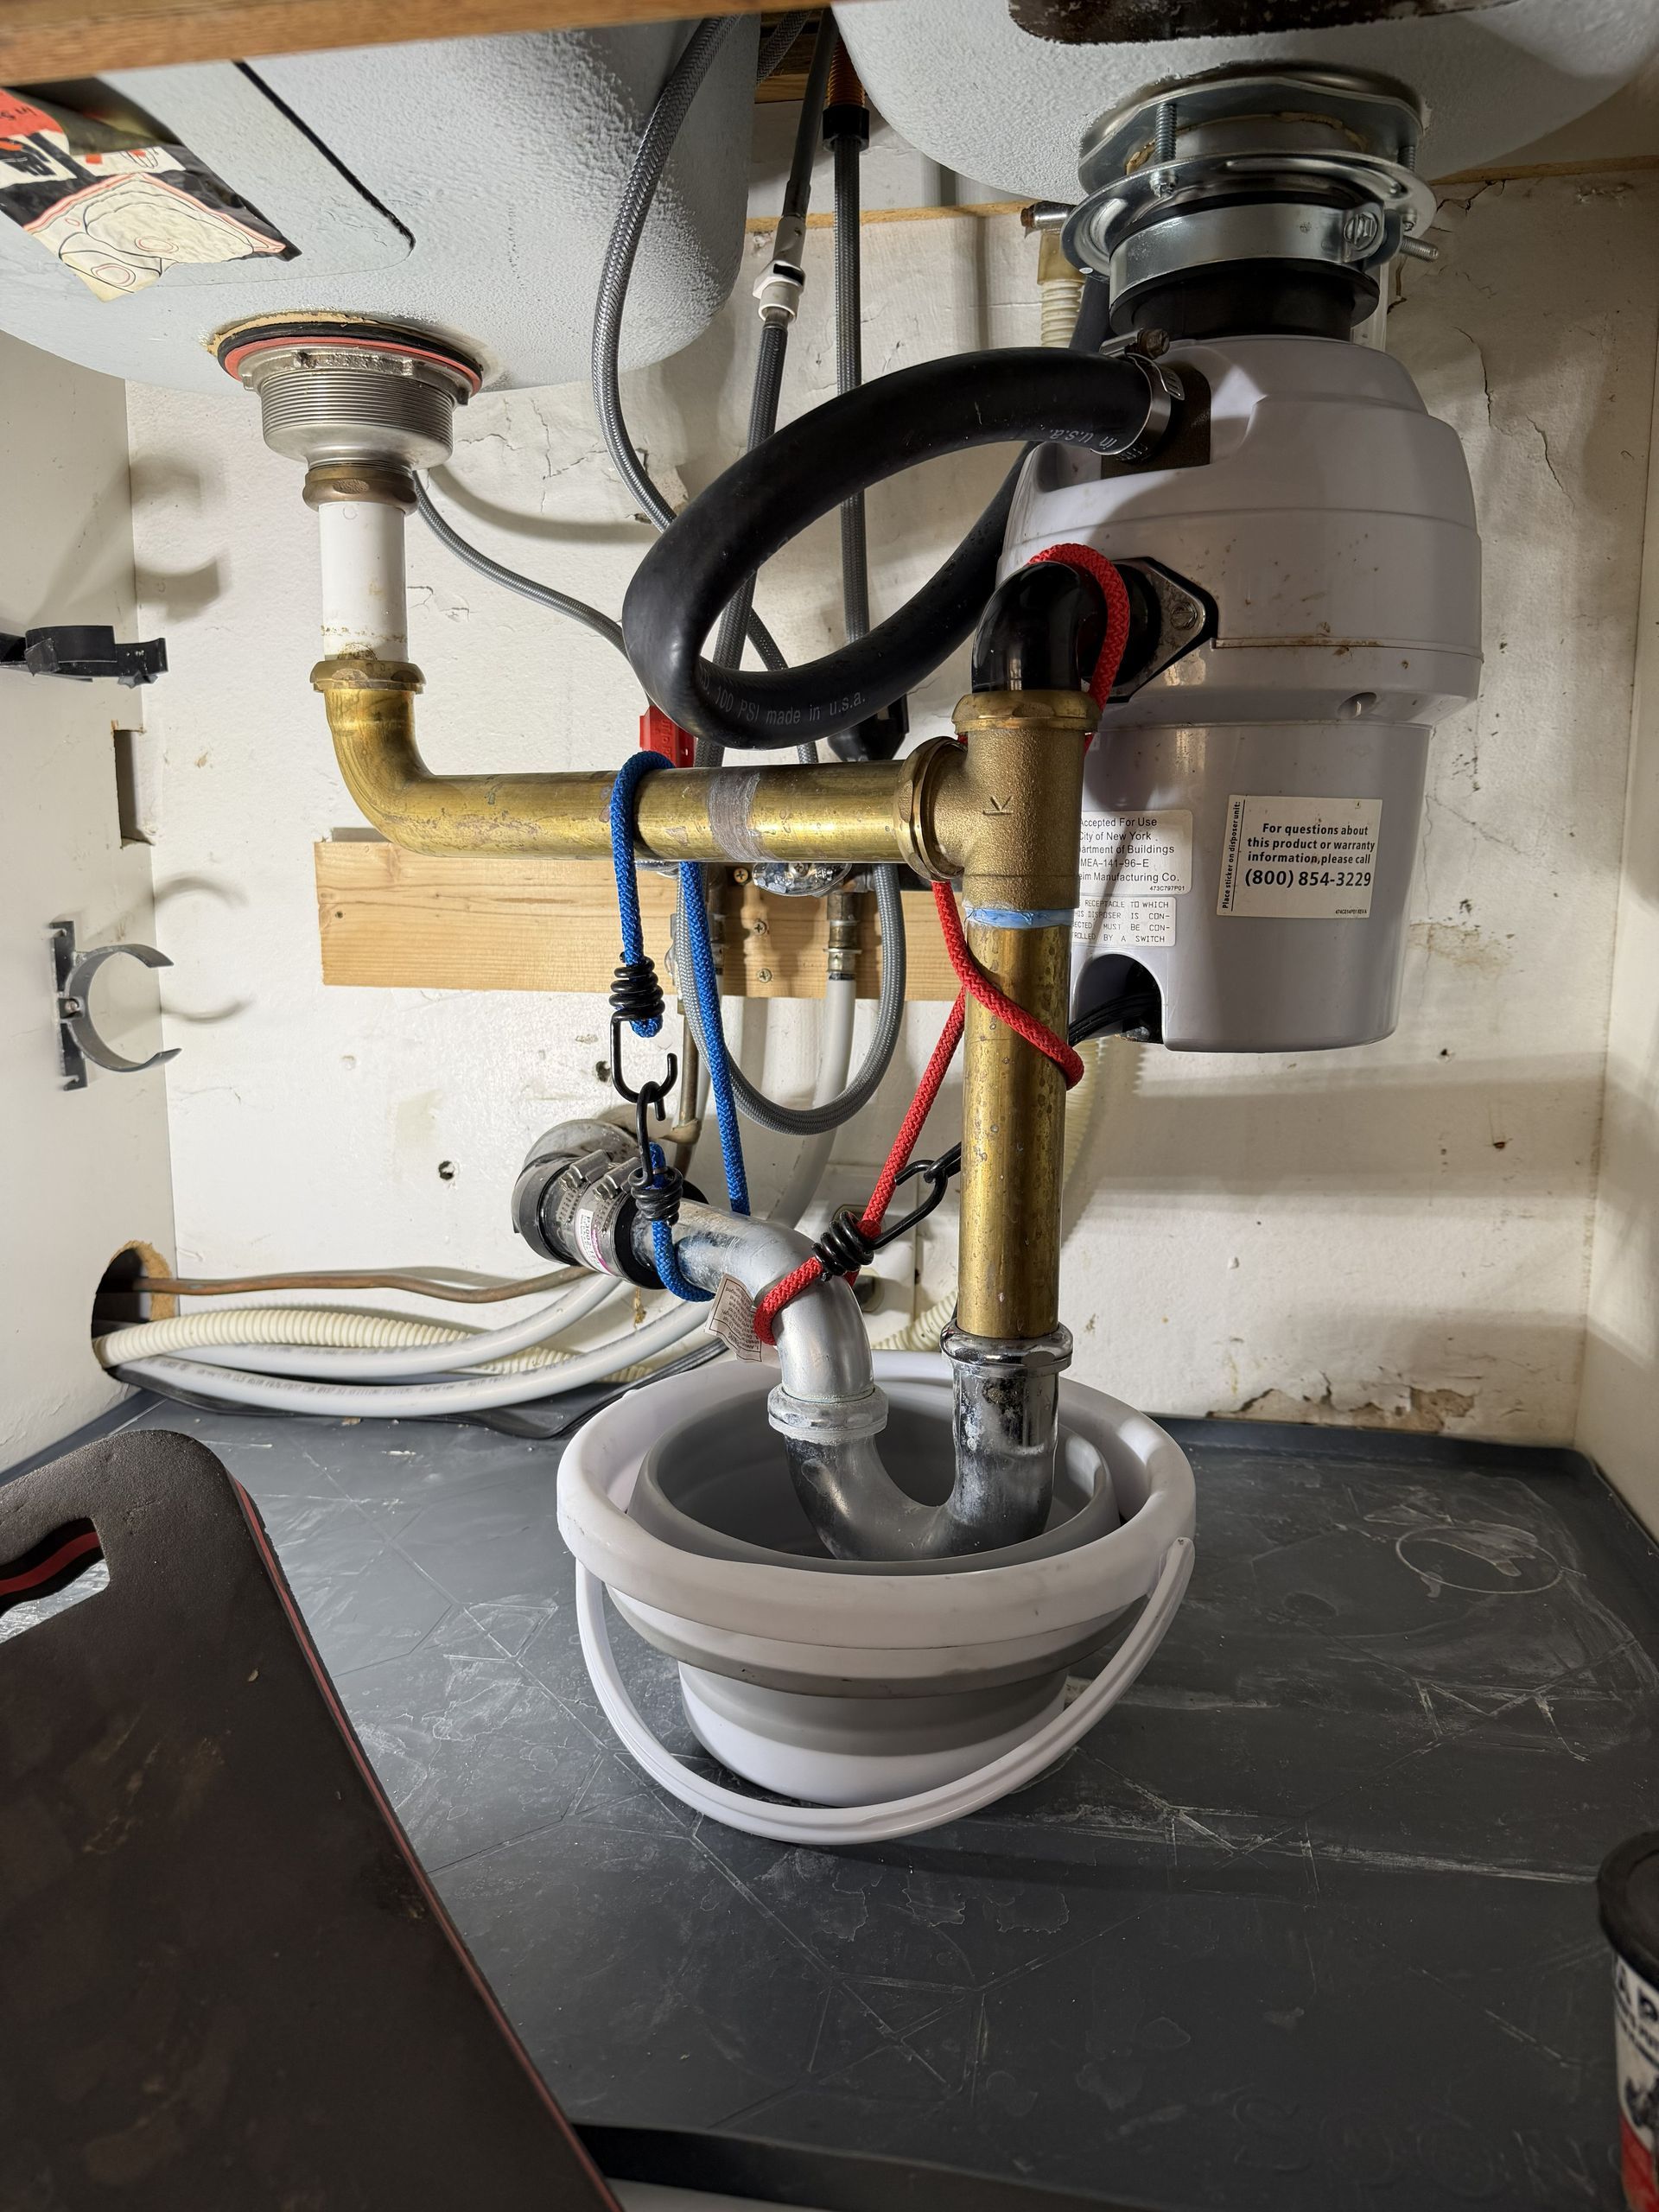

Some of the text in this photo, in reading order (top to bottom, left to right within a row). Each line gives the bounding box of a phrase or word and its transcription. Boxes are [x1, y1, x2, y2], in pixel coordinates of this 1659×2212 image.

[1050, 429, 1118, 450] in u.s.a.
[715, 686, 734, 713] 100
[737, 698, 760, 722] PSI
[766, 708, 802, 725] made
[809, 703, 821, 722] in
[829, 691, 866, 716] u.s.a.
[1119, 817, 1135, 827] For
[1137, 817, 1158, 827] Use
[1262, 823, 1369, 836] For questions about
[1095, 831, 1104, 841] of
[1106, 831, 1127, 841] New
[1129, 831, 1152, 841] York
[1229, 821, 1238, 852] disposer
[1080, 845, 1175, 855] artment of Buildings
[1247, 837, 1270, 848] this
[1272, 838, 1319, 850] product
[1333, 841, 1376, 853] warranty
[1228, 853, 1235, 863] on
[1355, 854, 1371, 864] call
[1093, 872, 1160, 883] Manufacturing
[1161, 872, 1180, 882] Co.
[1224, 864, 1234, 888] sticker
[1245, 868, 1372, 888] (800) 854-3229
[1084, 899, 1126, 908] RECEPTACLE
[1222, 890, 1230, 909] Place
[1088, 911, 1122, 919] DISPOSER
[1072, 932, 1096, 941] ROLLED
